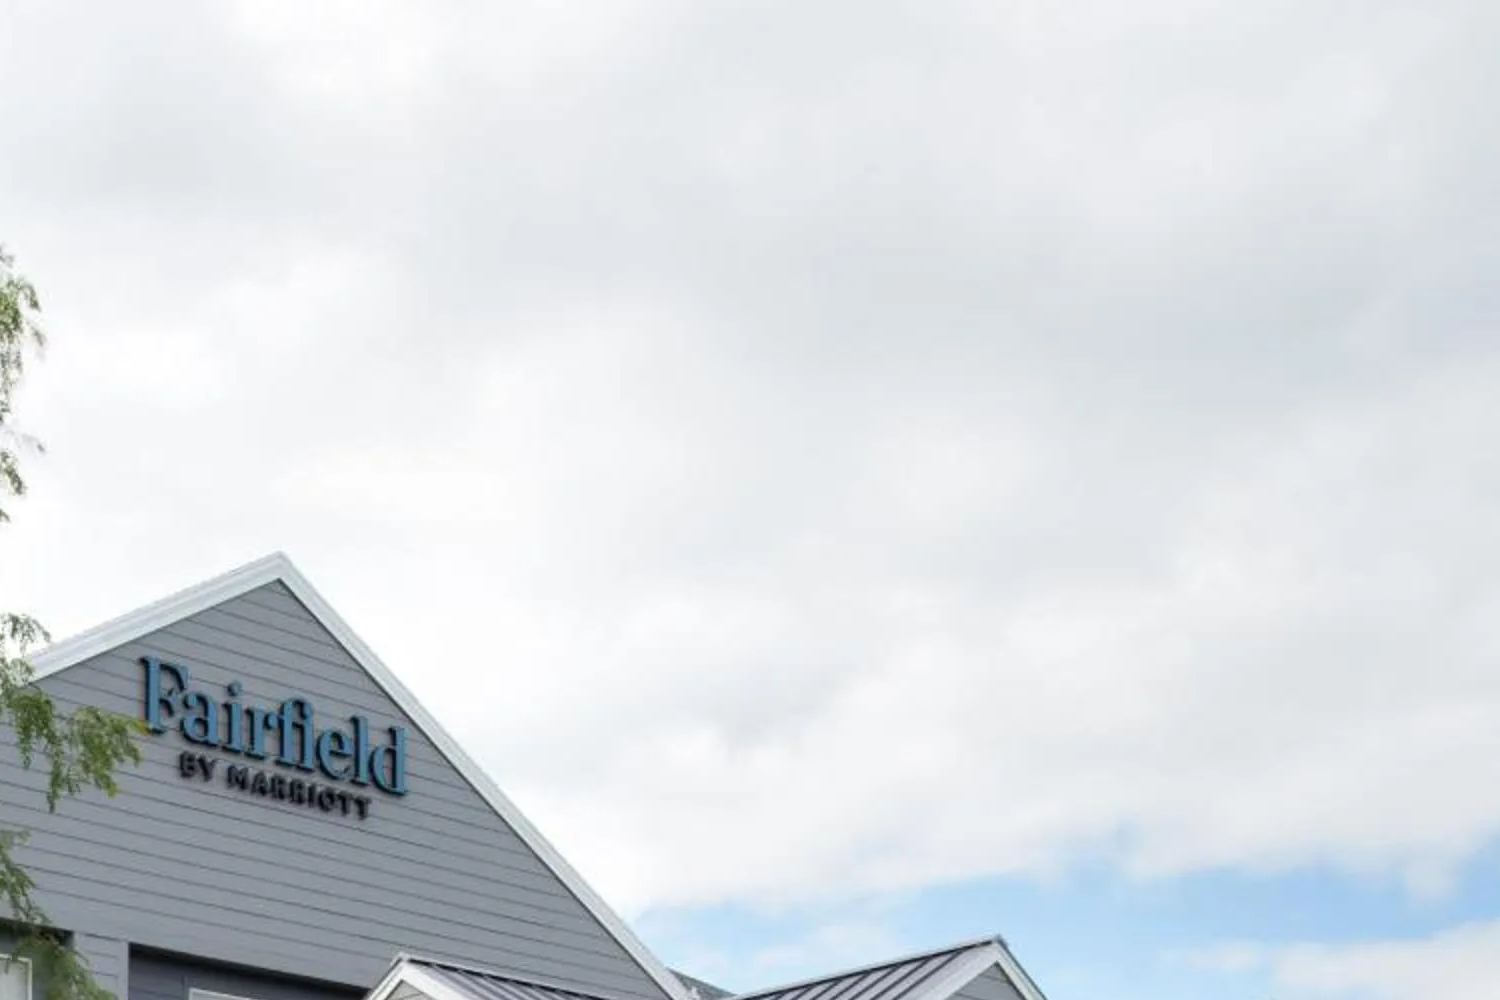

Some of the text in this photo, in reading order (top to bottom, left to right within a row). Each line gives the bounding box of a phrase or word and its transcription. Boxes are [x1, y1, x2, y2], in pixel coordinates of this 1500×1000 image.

[140, 655, 409, 796] Fairfield
[179, 751, 372, 819] BY MARRIOTT
